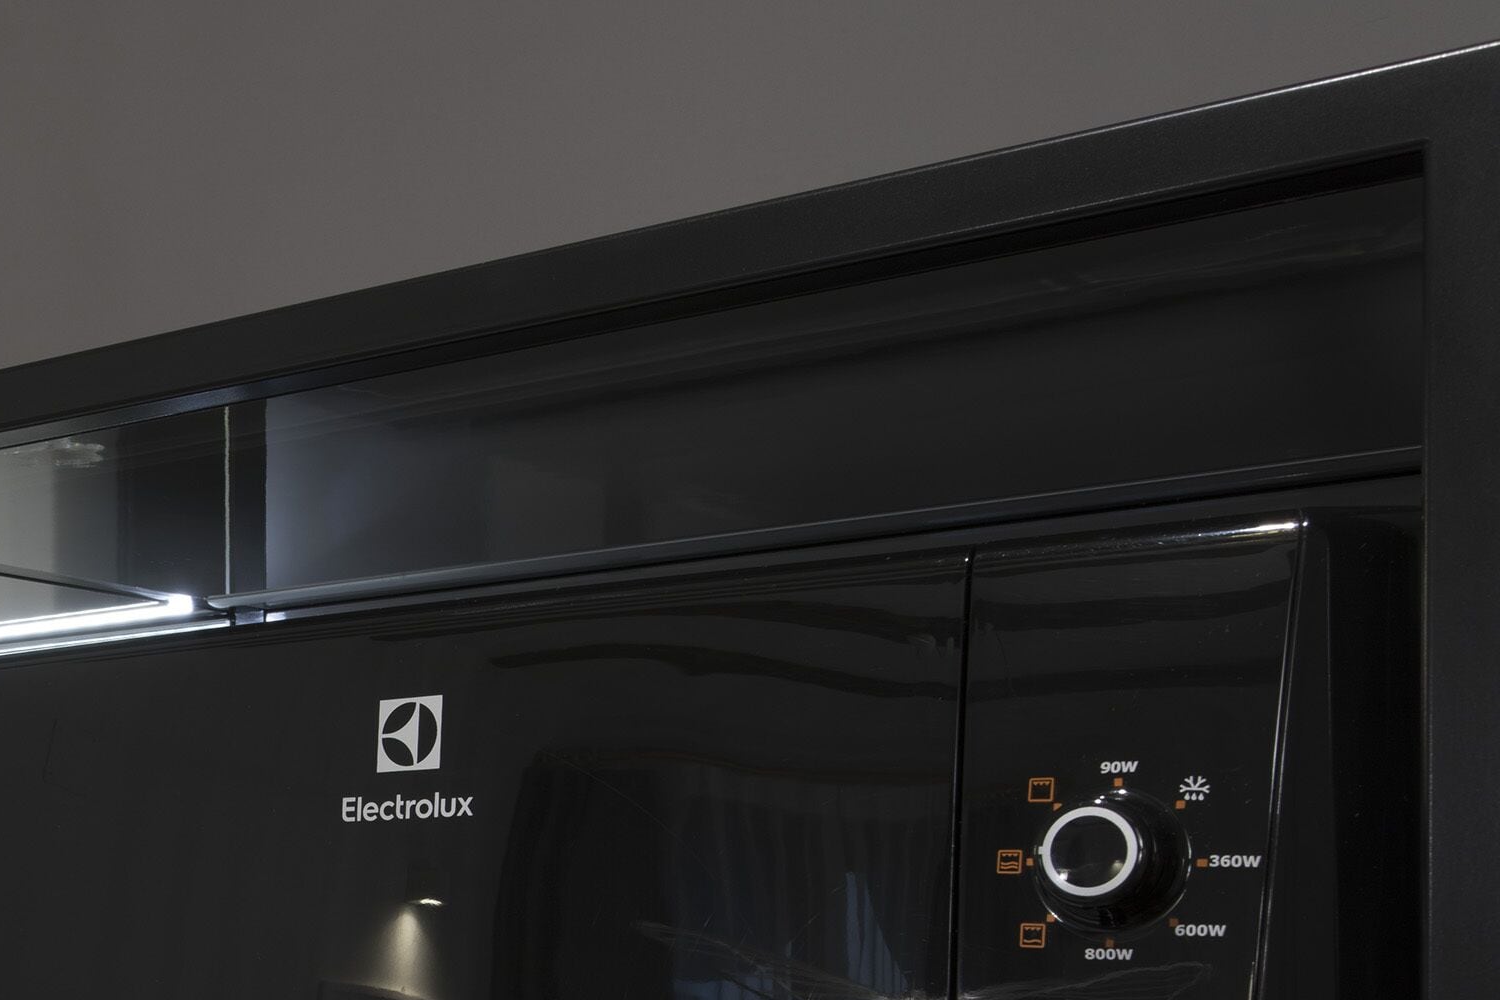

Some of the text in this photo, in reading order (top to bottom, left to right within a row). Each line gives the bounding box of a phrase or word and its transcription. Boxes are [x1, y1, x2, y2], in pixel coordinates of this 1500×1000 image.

[1099, 760, 1139, 775] 90W
[342, 792, 473, 822] Electrolux
[1208, 854, 1262, 868] 360W
[1174, 924, 1227, 937] 600W
[1084, 947, 1134, 961] 800W
